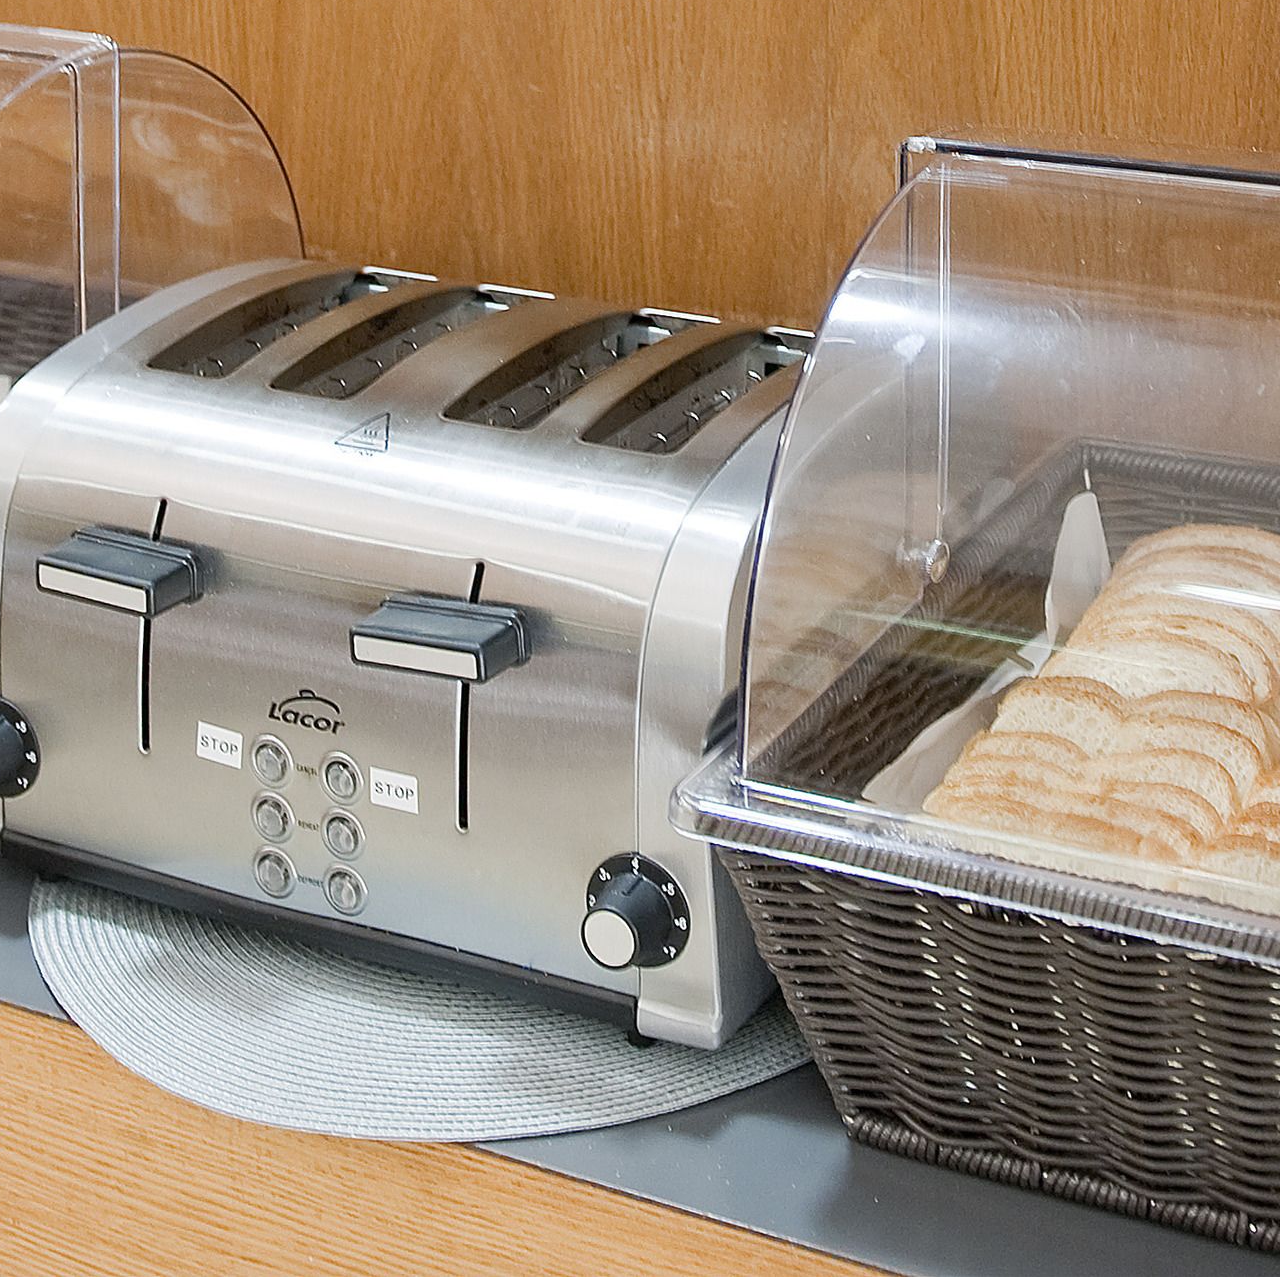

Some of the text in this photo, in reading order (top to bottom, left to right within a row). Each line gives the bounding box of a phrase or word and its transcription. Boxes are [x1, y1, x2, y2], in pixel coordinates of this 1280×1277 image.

[269, 700, 345, 735] Lacor
[200, 734, 239, 756] STOP
[374, 781, 415, 801] STOP
